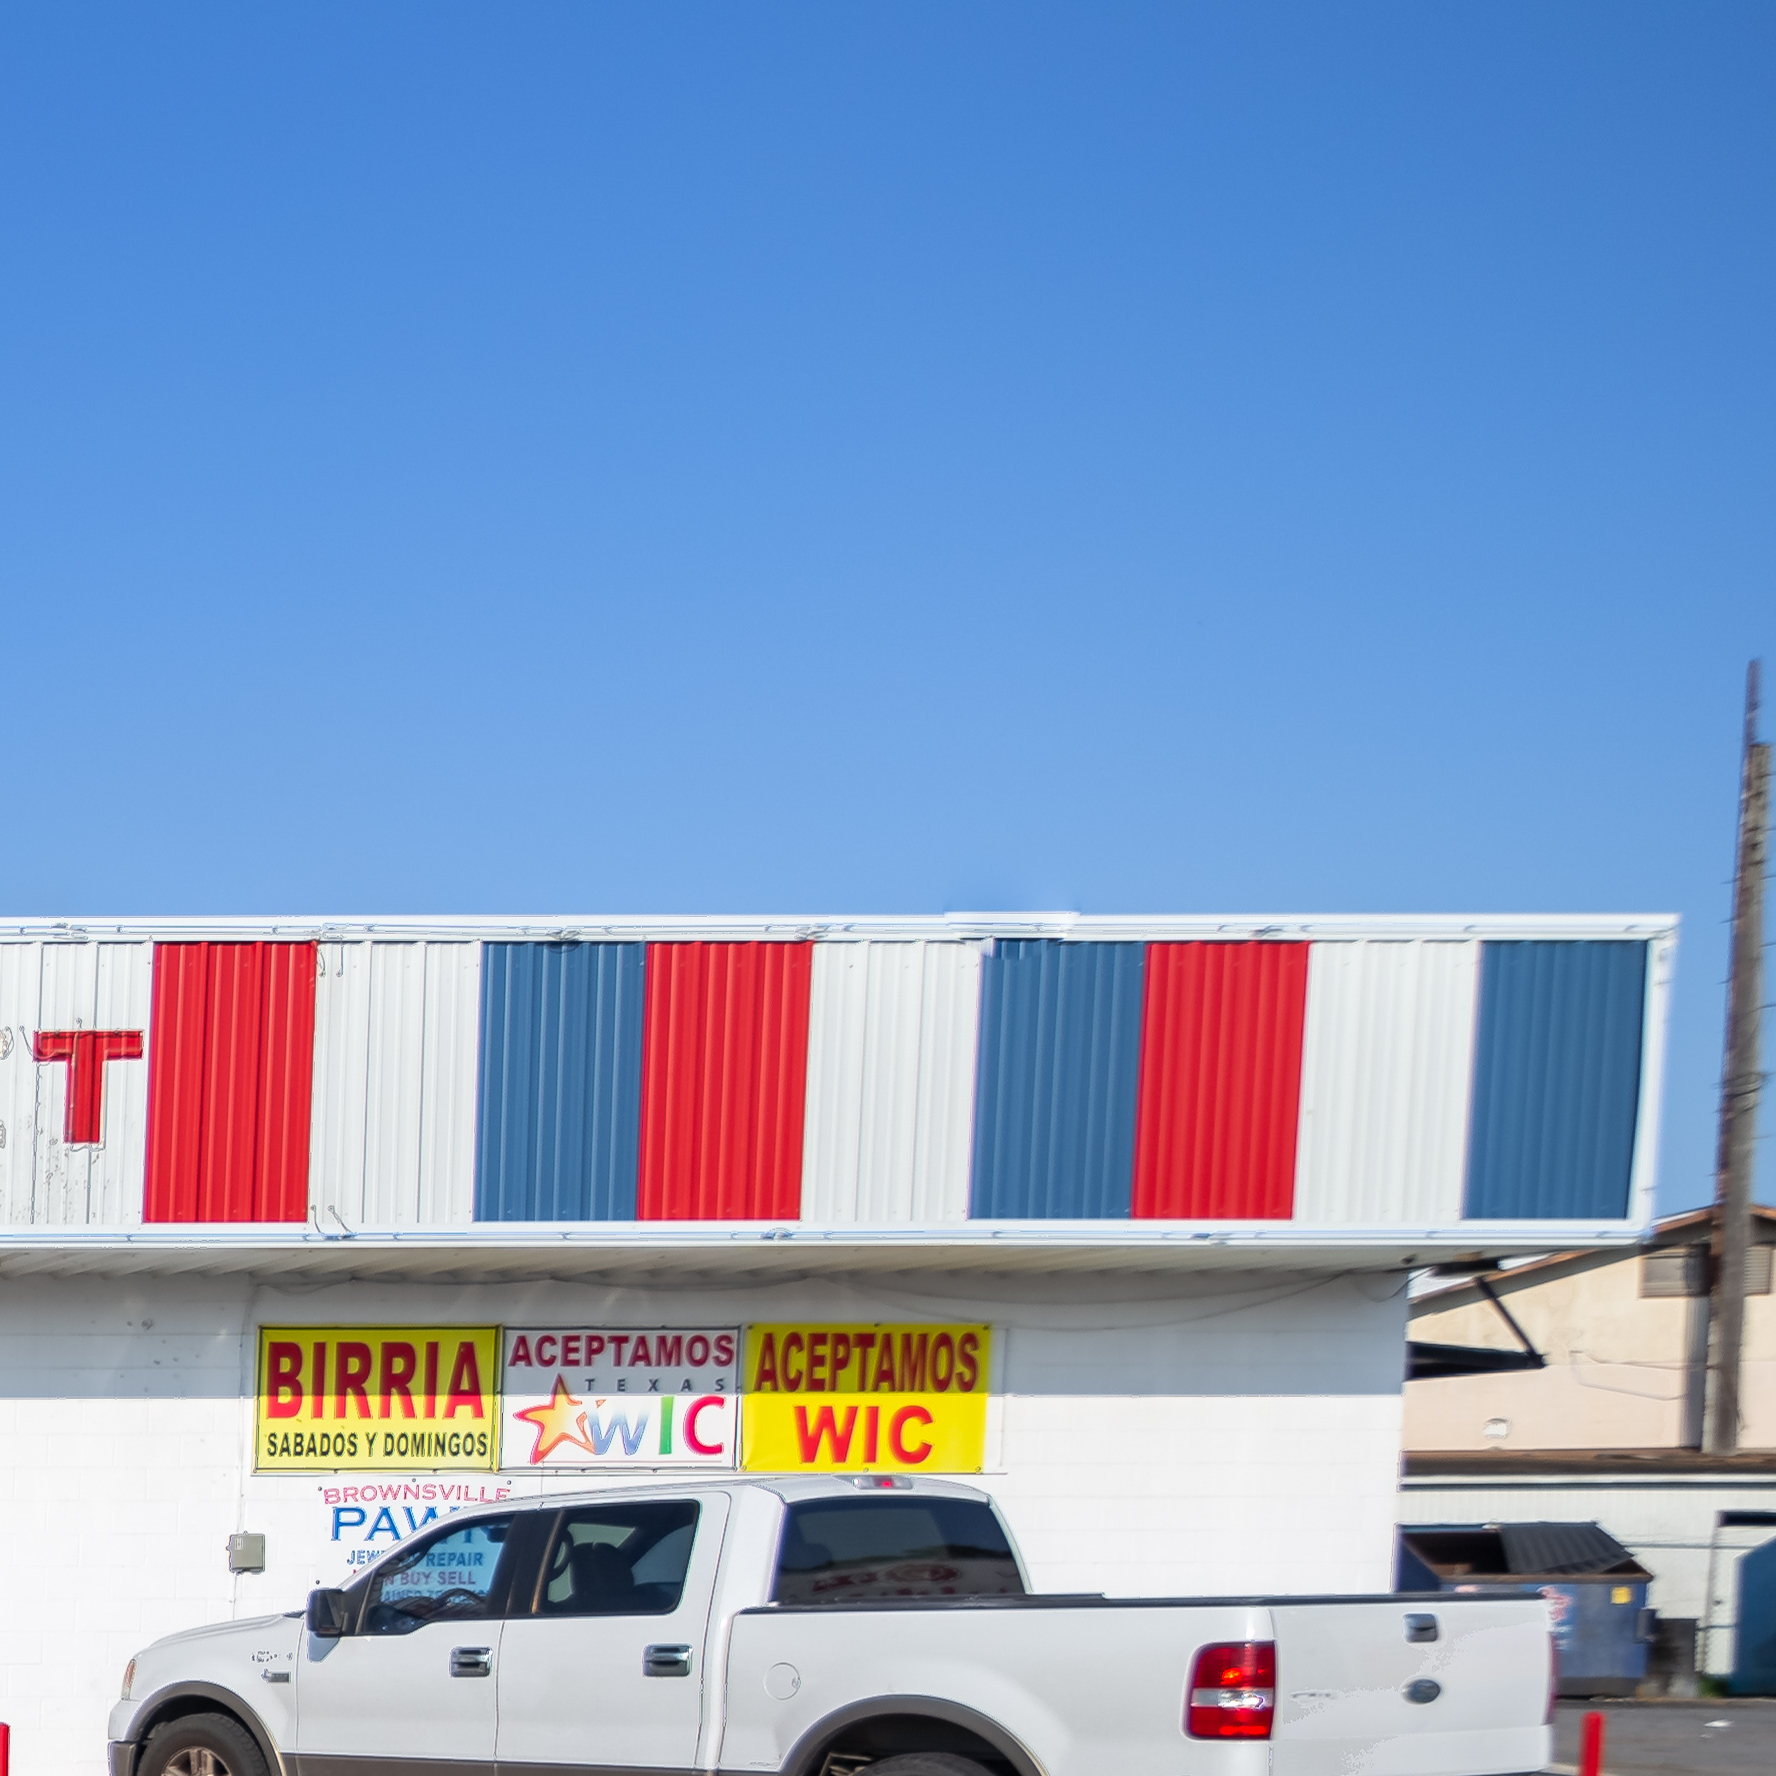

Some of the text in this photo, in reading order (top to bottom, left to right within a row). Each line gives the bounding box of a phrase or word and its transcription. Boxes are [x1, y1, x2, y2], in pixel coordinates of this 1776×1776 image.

[508, 1334, 735, 1368] ACEPTAMOS
[753, 1331, 980, 1393] ACEPTAMOS
[266, 1341, 486, 1420] BIRRIA
[585, 1378, 725, 1392] TEXAS
[267, 1431, 488, 1457] SABADOS Y DOMINGOS
[793, 1404, 934, 1465] WIC
[323, 1483, 511, 1504] BROWNSVILLE
[425, 1551, 483, 1567] REPAIR
[400, 1571, 431, 1585] BUY
[437, 1571, 476, 1585] SELL
